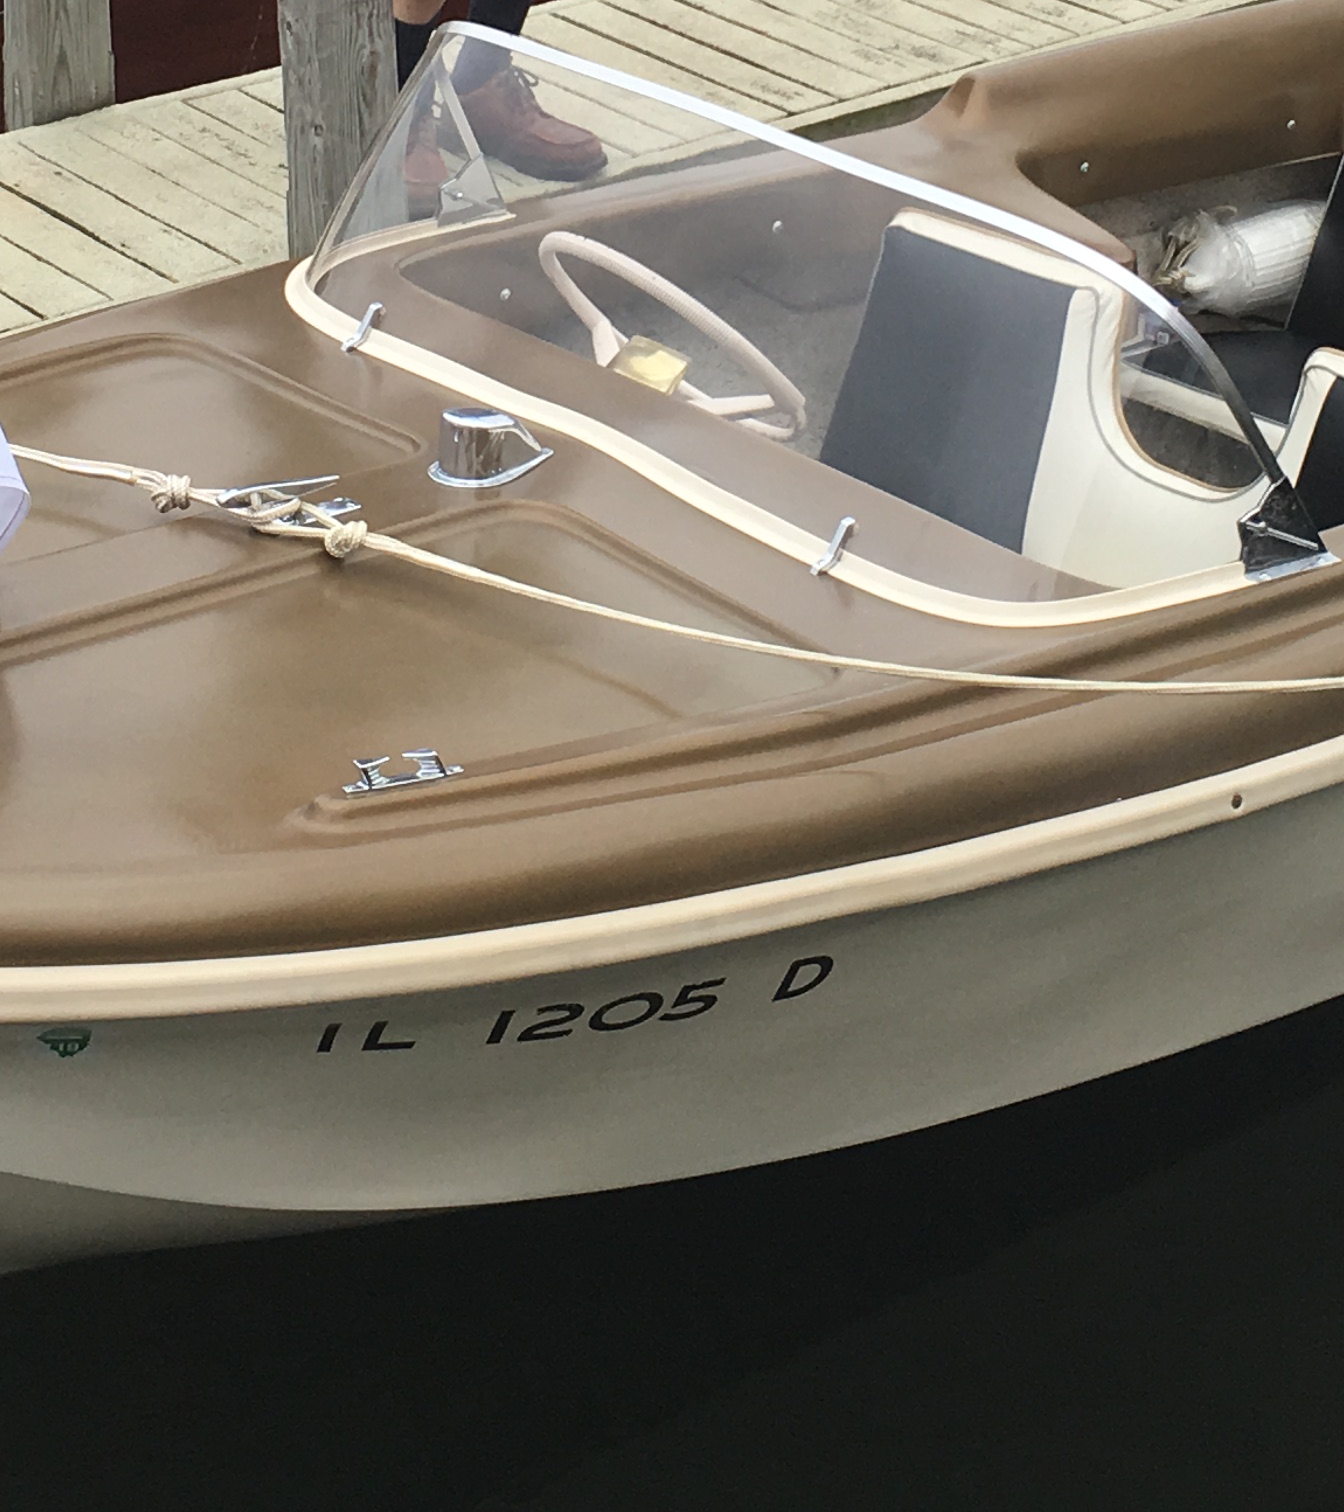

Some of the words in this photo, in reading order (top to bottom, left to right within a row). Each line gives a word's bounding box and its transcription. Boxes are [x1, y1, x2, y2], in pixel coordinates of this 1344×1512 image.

[316, 1020, 417, 1054] IL
[485, 978, 727, 1045] 1205
[771, 955, 834, 1002] D
